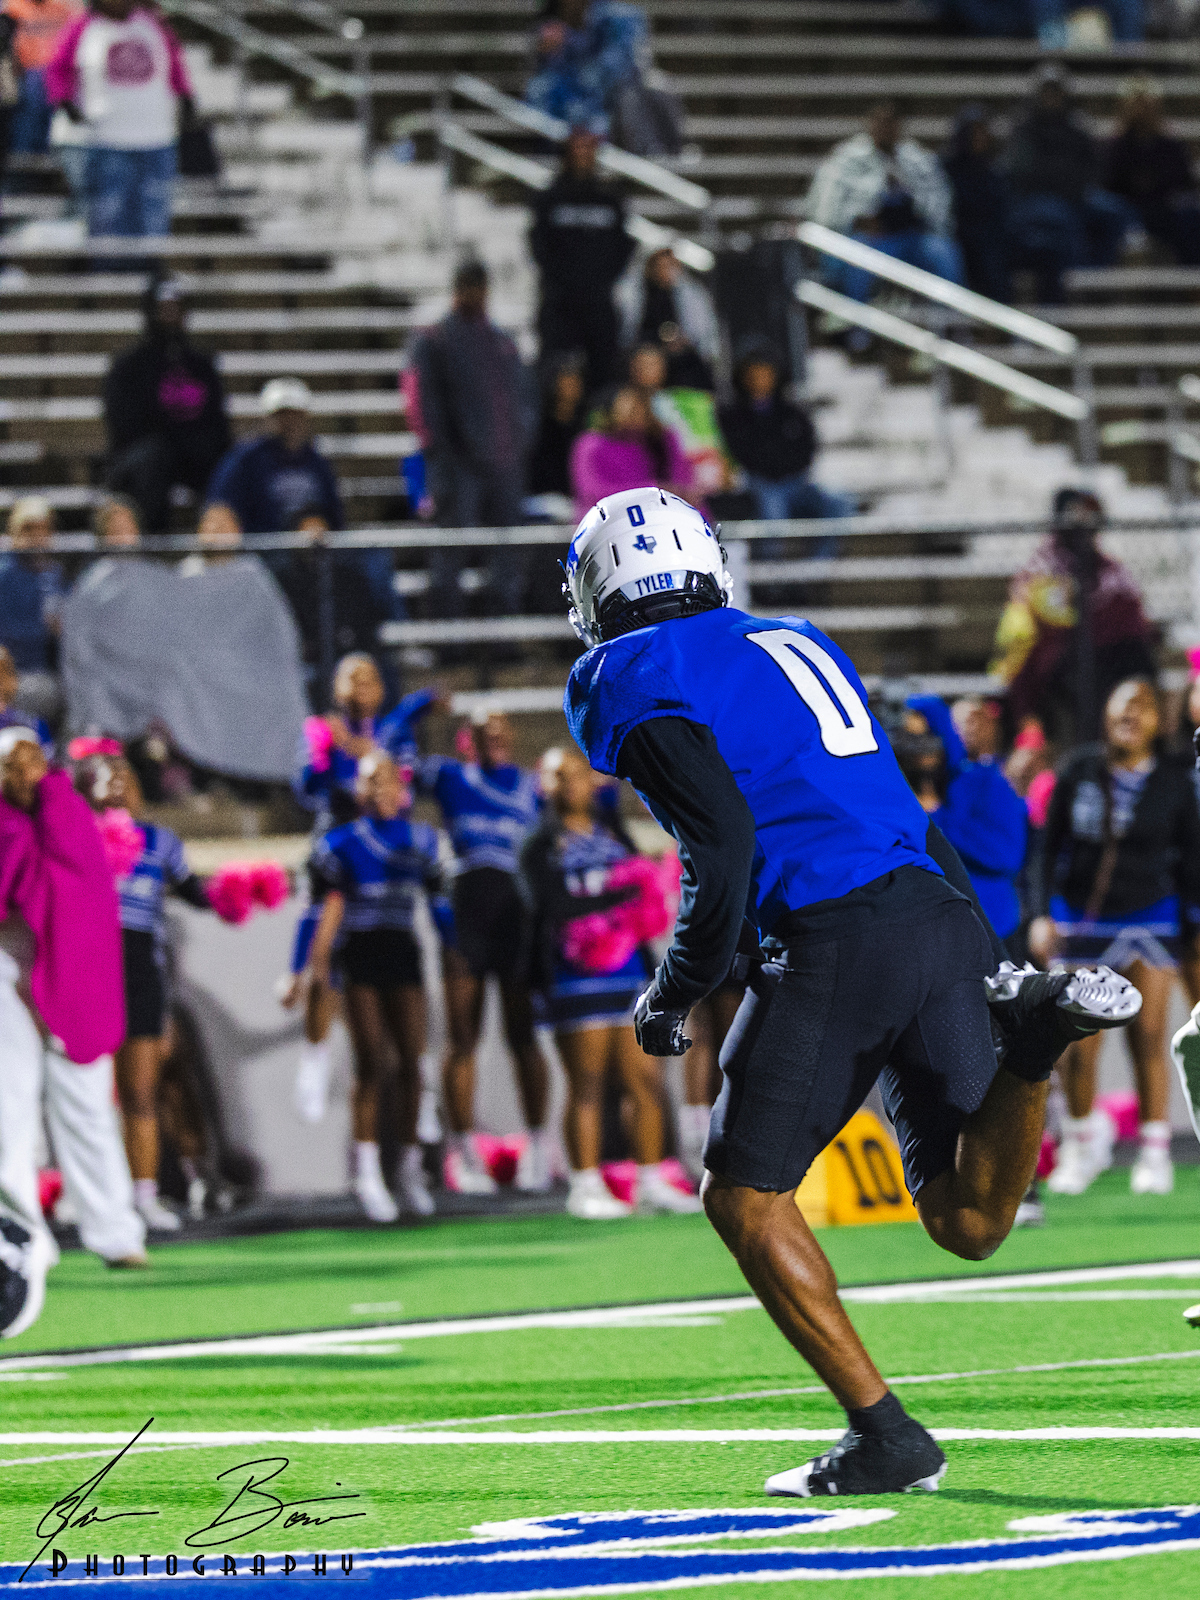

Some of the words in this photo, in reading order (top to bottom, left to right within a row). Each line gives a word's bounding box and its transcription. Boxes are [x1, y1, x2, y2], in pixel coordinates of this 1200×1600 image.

[626, 504, 646, 527] 0
[635, 573, 674, 596] TYLER
[745, 628, 879, 758] 0
[834, 1138, 903, 1209] 10
